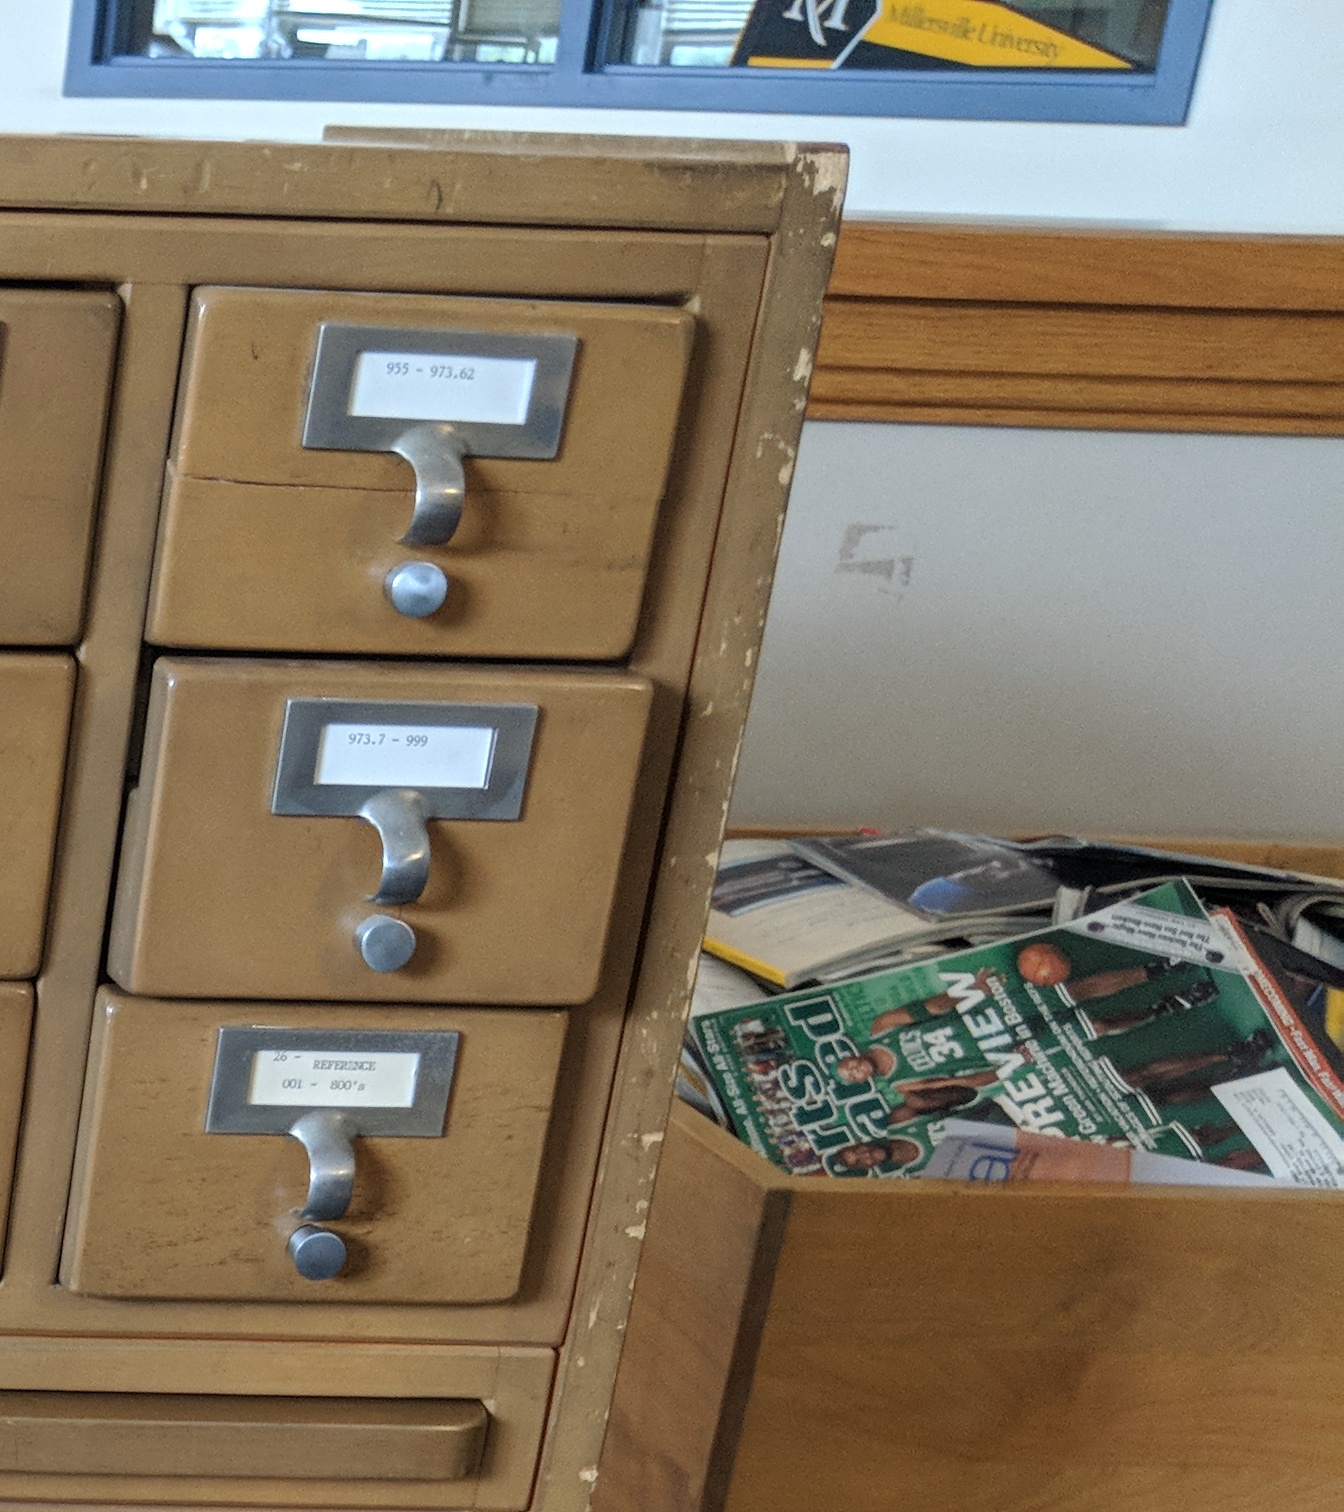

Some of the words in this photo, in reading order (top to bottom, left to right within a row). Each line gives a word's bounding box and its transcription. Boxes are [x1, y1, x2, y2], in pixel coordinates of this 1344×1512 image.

[979, 21, 1063, 58] University
[387, 363, 409, 375] 955
[430, 366, 475, 380] 973.62
[349, 733, 385, 745] 973.7
[407, 735, 428, 747] 999
[985, 975, 1024, 1027] Boston
[923, 1026, 964, 1063] 34
[1014, 1023, 1033, 1040] in
[274, 1052, 287, 1062] 26
[313, 1060, 376, 1071] REFERENCE
[938, 972, 1067, 1140] REVIEW
[1025, 1038, 1070, 1096] Machine
[282, 1079, 302, 1089] 001
[330, 1080, 366, 1091] 800's
[1063, 1096, 1097, 1134] Green
